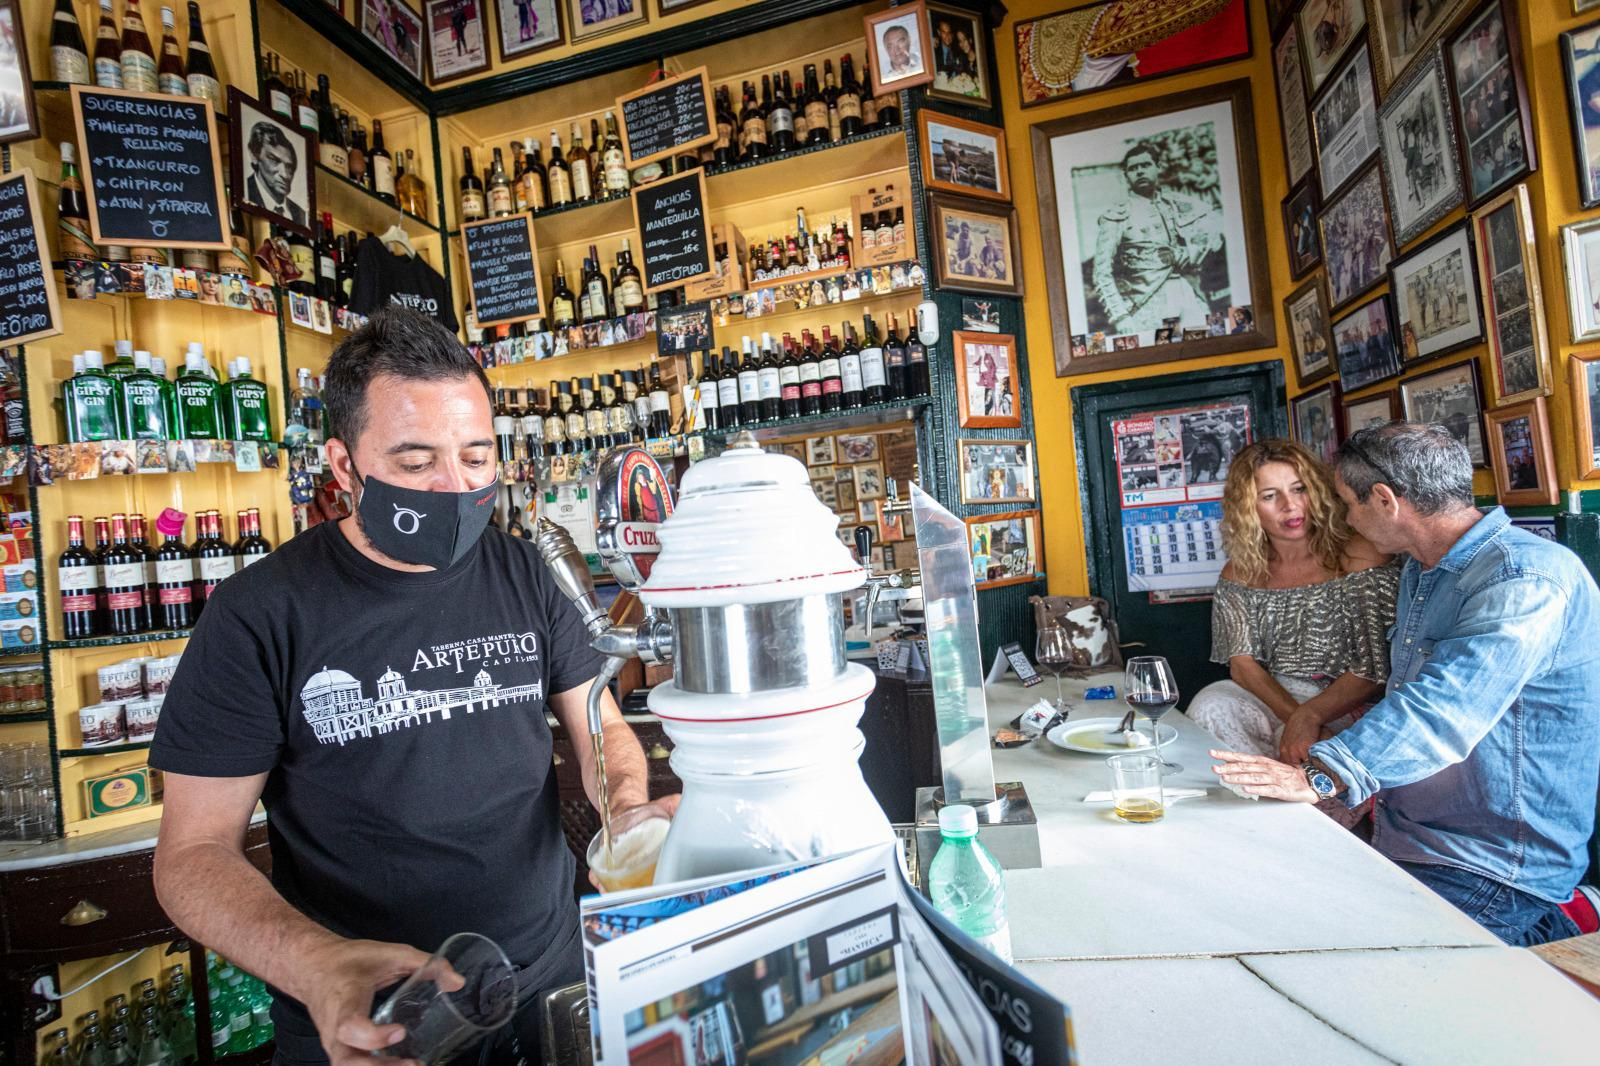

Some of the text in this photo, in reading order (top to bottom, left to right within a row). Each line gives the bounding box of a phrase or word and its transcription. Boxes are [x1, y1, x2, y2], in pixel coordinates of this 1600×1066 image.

[122, 137, 184, 152] RELLENOS
[77, 386, 112, 396] GIPSY
[127, 385, 161, 395] GIPSY
[180, 387, 213, 397] GIPSY
[236, 389, 266, 399] GIPSY
[84, 396, 105, 406] GIN
[134, 396, 154, 405] GIN
[187, 397, 207, 406] GIN
[243, 399, 261, 408] GIN
[1151, 526, 1156, 534] 2
[1169, 525, 1174, 533] 3
[1186, 523, 1191, 531] 4
[1187, 533, 1194, 541] 11
[1204, 532, 1212, 540] 12
[1135, 542, 1214, 555] 15 16 17 18 19
[1135, 557, 1144, 565] 22
[1153, 556, 1161, 564] 23
[1188, 553, 1197, 561] 25
[1206, 552, 1216, 560] 26
[1136, 566, 1163, 575] 29 30
[430, 641, 465, 652] TABERNA
[467, 638, 486, 646] CASA
